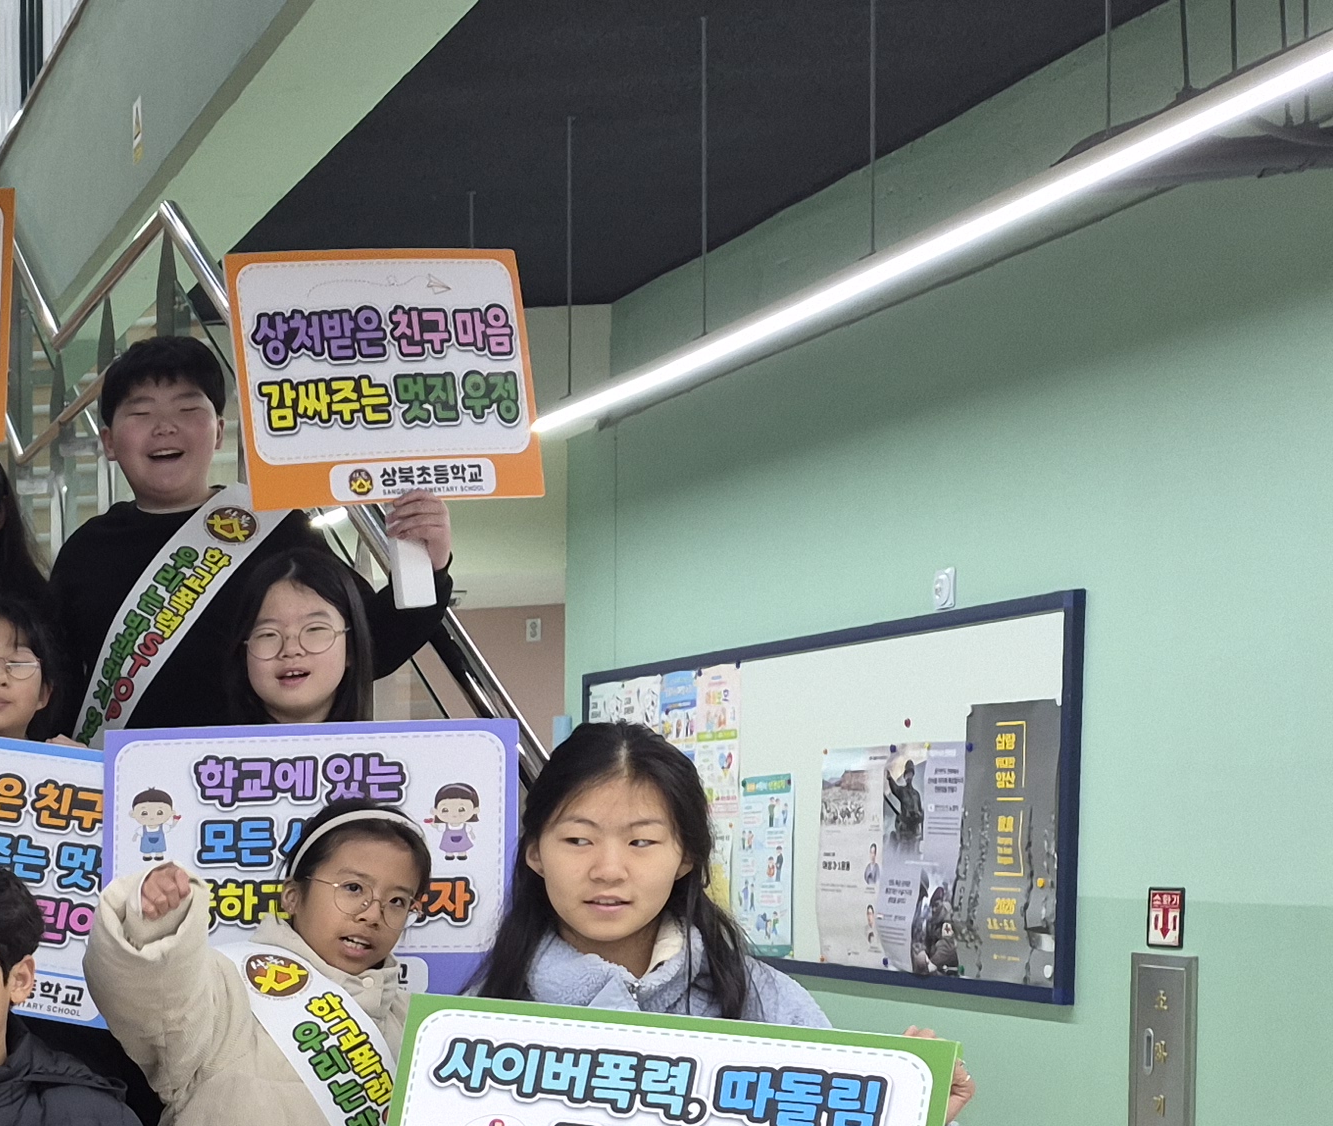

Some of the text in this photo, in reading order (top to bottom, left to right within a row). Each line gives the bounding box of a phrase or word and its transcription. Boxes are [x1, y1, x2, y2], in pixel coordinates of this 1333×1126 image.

[252, 304, 515, 366] 상처받은 친구 마음
[259, 370, 520, 433] 감싸주는 멋진 우정
[380, 464, 483, 487] 상북초등학교
[136, 545, 200, 618] 우리는
[34, 780, 103, 834] 친구
[194, 753, 407, 805] 학교에 있는
[199, 818, 276, 866] 모든
[1152, 893, 1180, 905] 소화기
[46, 1005, 81, 1016] SCHOOL
[292, 1020, 365, 1114] 우리는
[434, 1037, 709, 1126] 사이버폭력,
[1153, 990, 1169, 1118] 소화기
